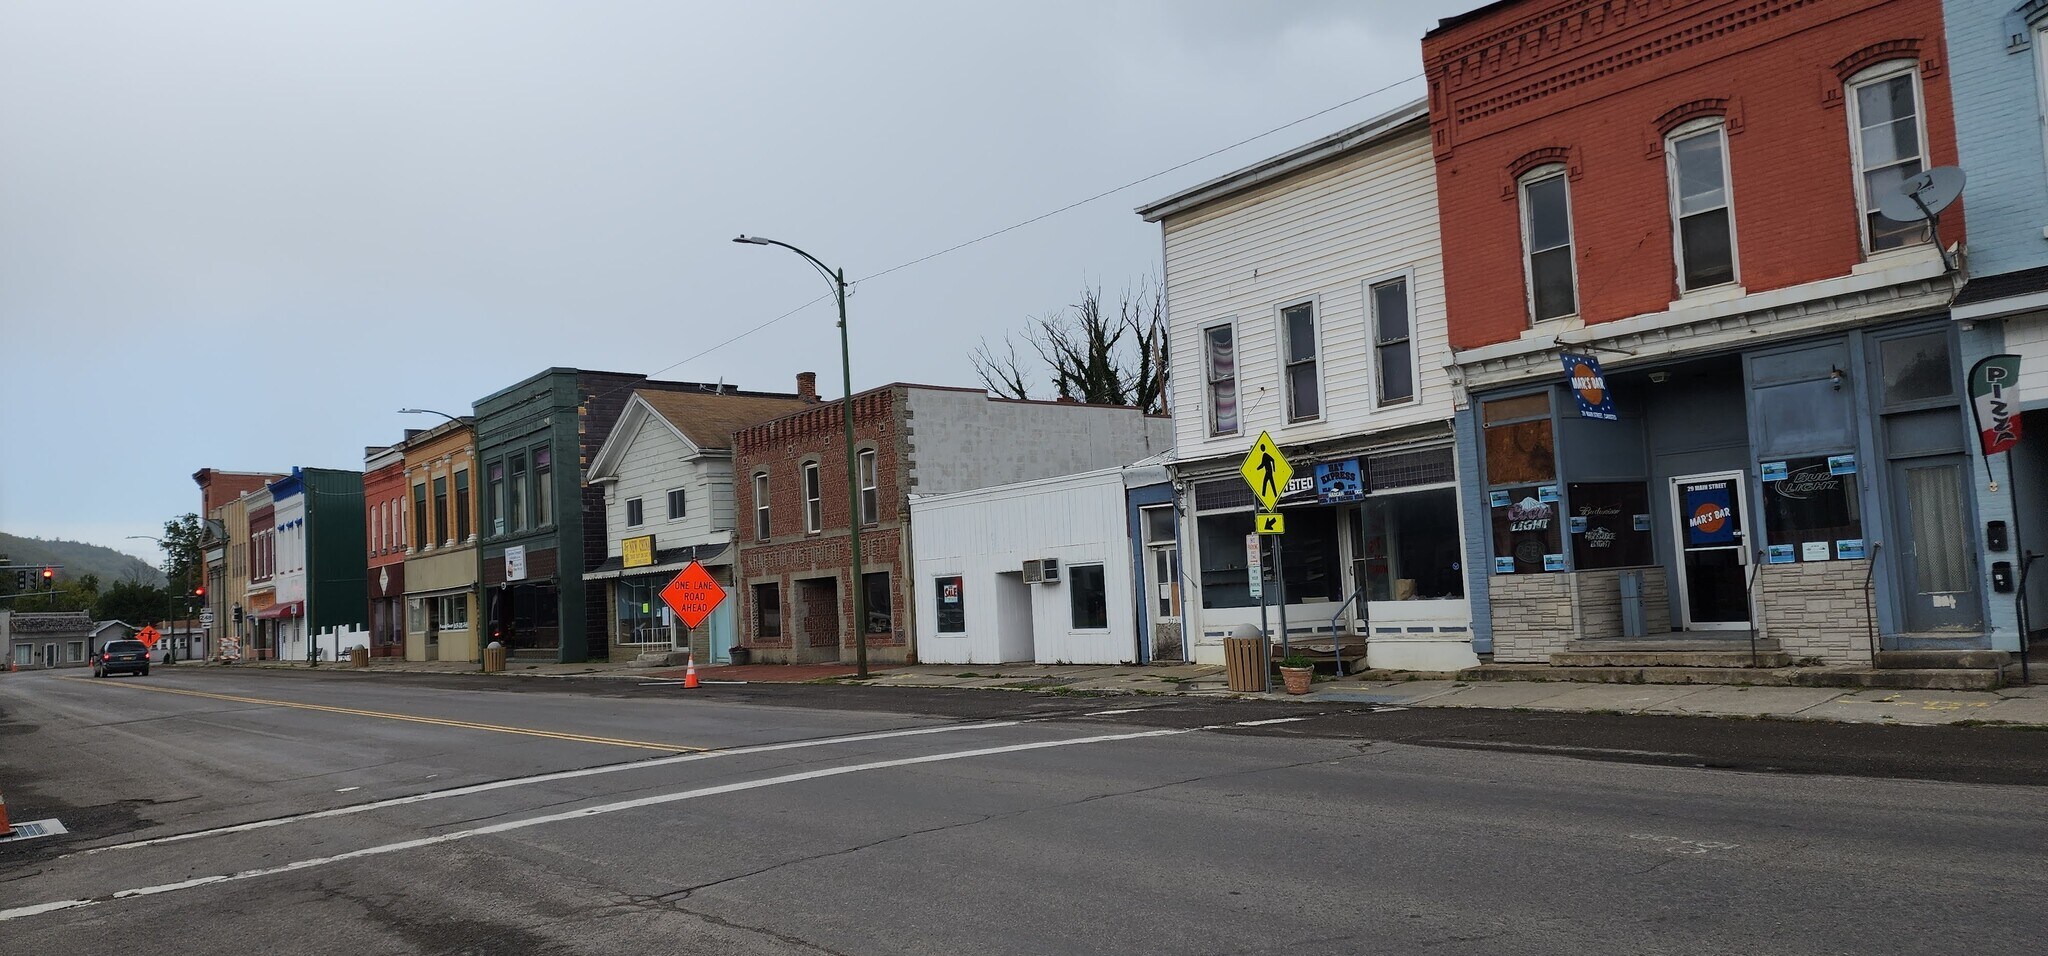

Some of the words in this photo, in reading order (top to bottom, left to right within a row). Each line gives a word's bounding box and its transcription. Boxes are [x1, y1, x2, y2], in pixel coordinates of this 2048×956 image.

[1986, 366, 2017, 447] PIZZA
[1320, 471, 1356, 484] EXPRESS
[1708, 482, 1727, 490] STREET
[1785, 480, 1838, 492] LIGHT
[1690, 512, 1713, 528] MAR'S
[1713, 507, 1731, 520] BAR
[1510, 519, 1549, 532] LIGHT
[674, 581, 690, 590] ONE
[693, 581, 713, 590] LANE
[684, 592, 706, 601] ROAD
[682, 603, 708, 612] AHEAD
